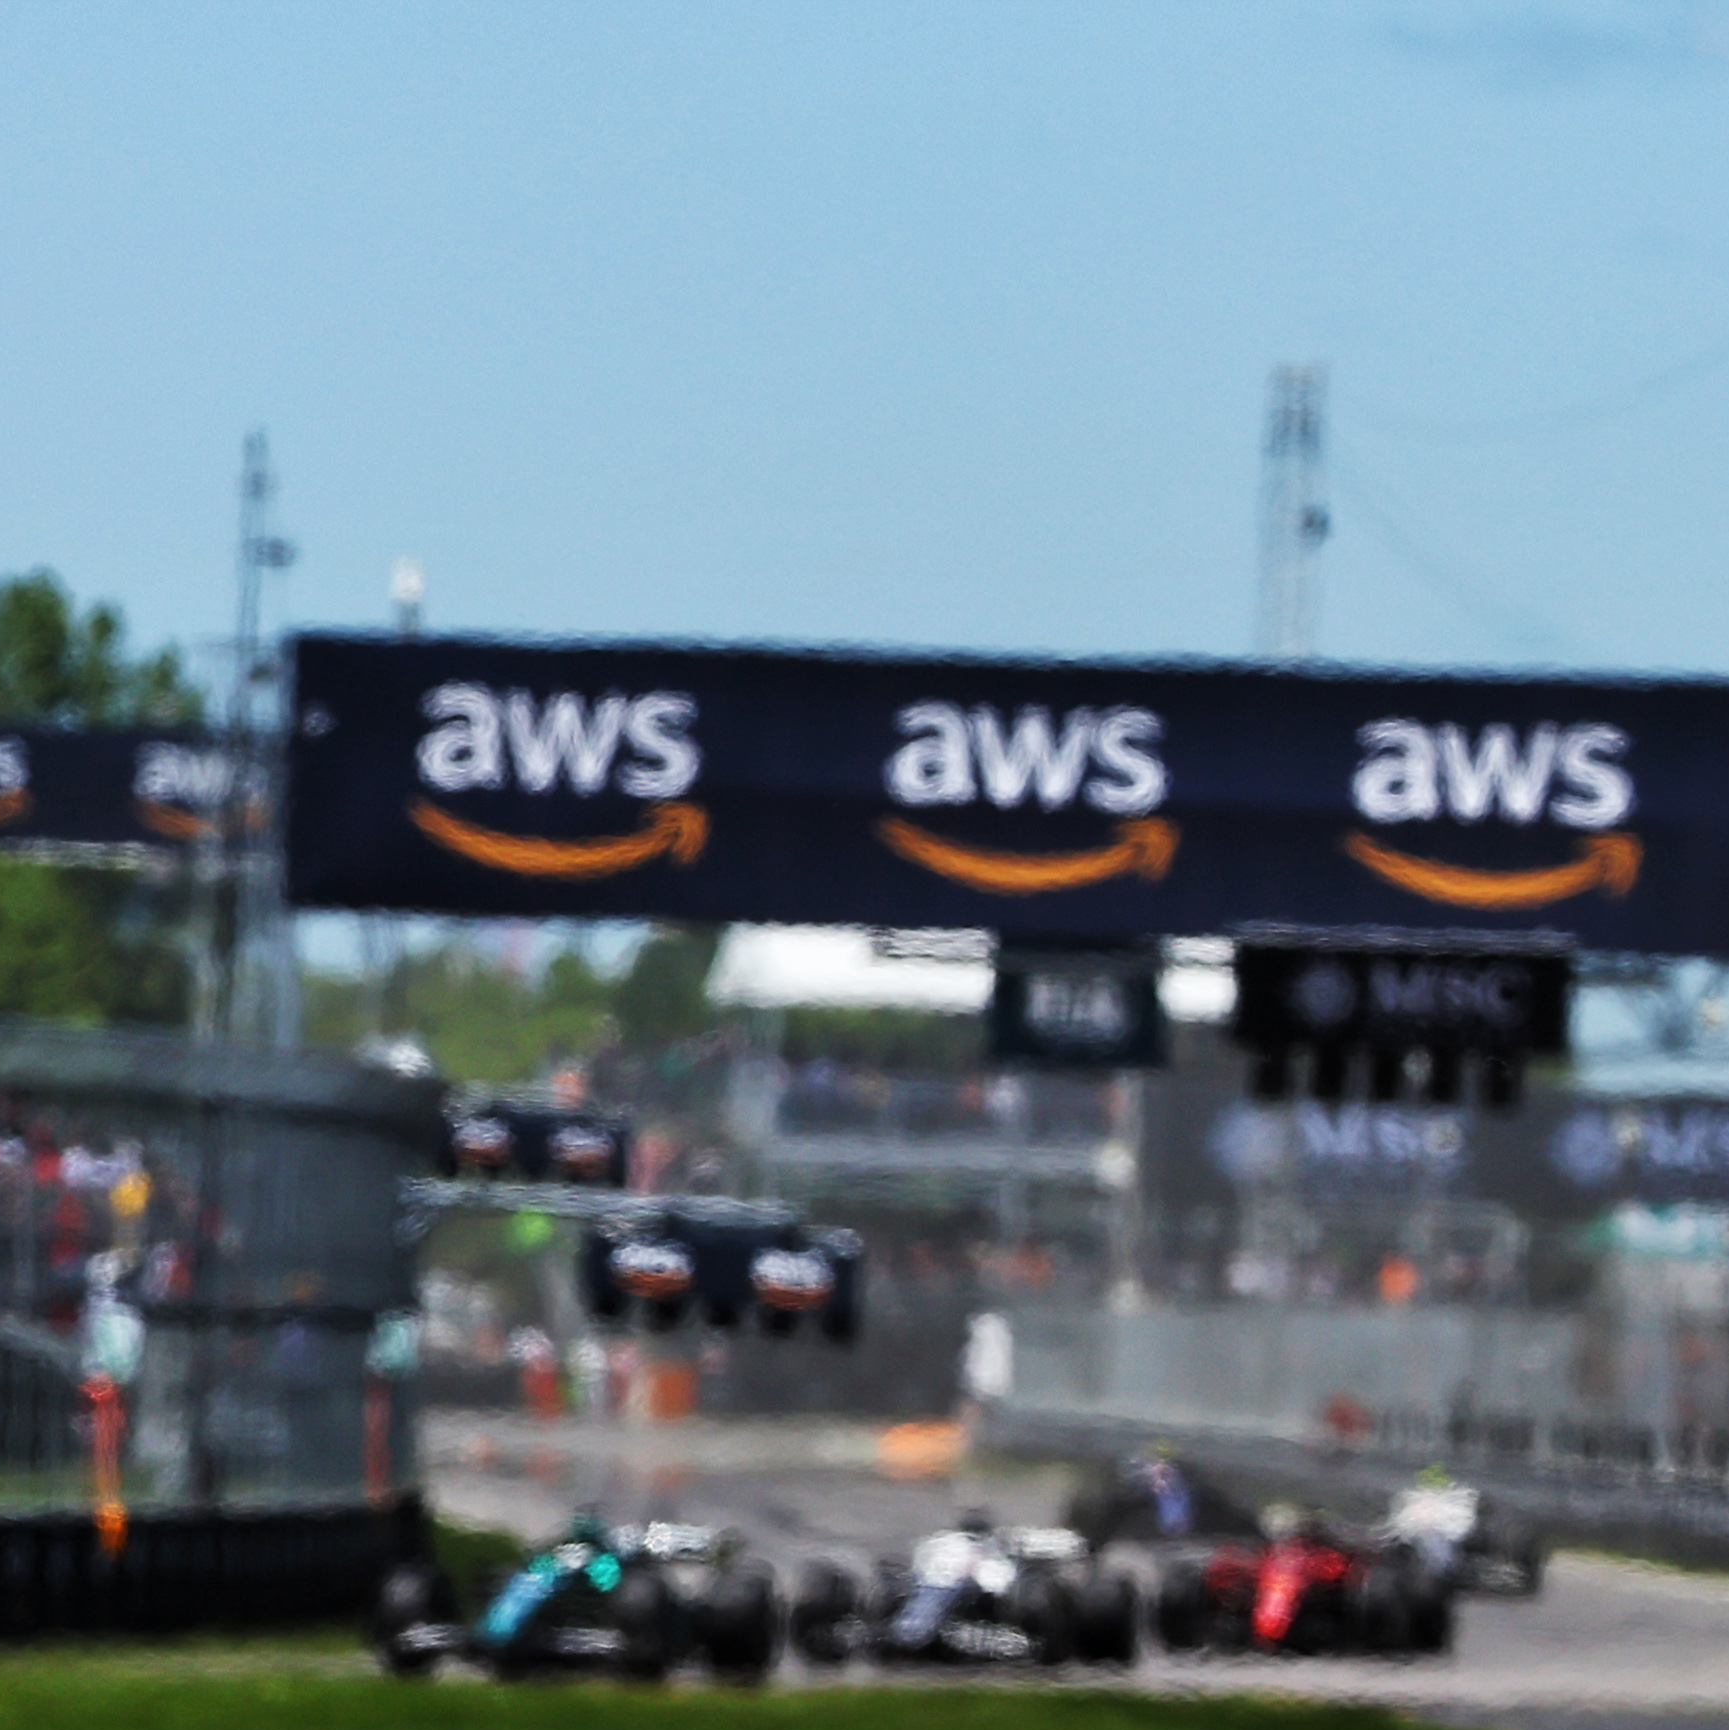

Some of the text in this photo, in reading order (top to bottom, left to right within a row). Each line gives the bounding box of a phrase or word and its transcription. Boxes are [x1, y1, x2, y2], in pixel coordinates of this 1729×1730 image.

[416, 678, 702, 799] aws
[885, 698, 1168, 816] aws
[1350, 716, 1637, 829] aws
